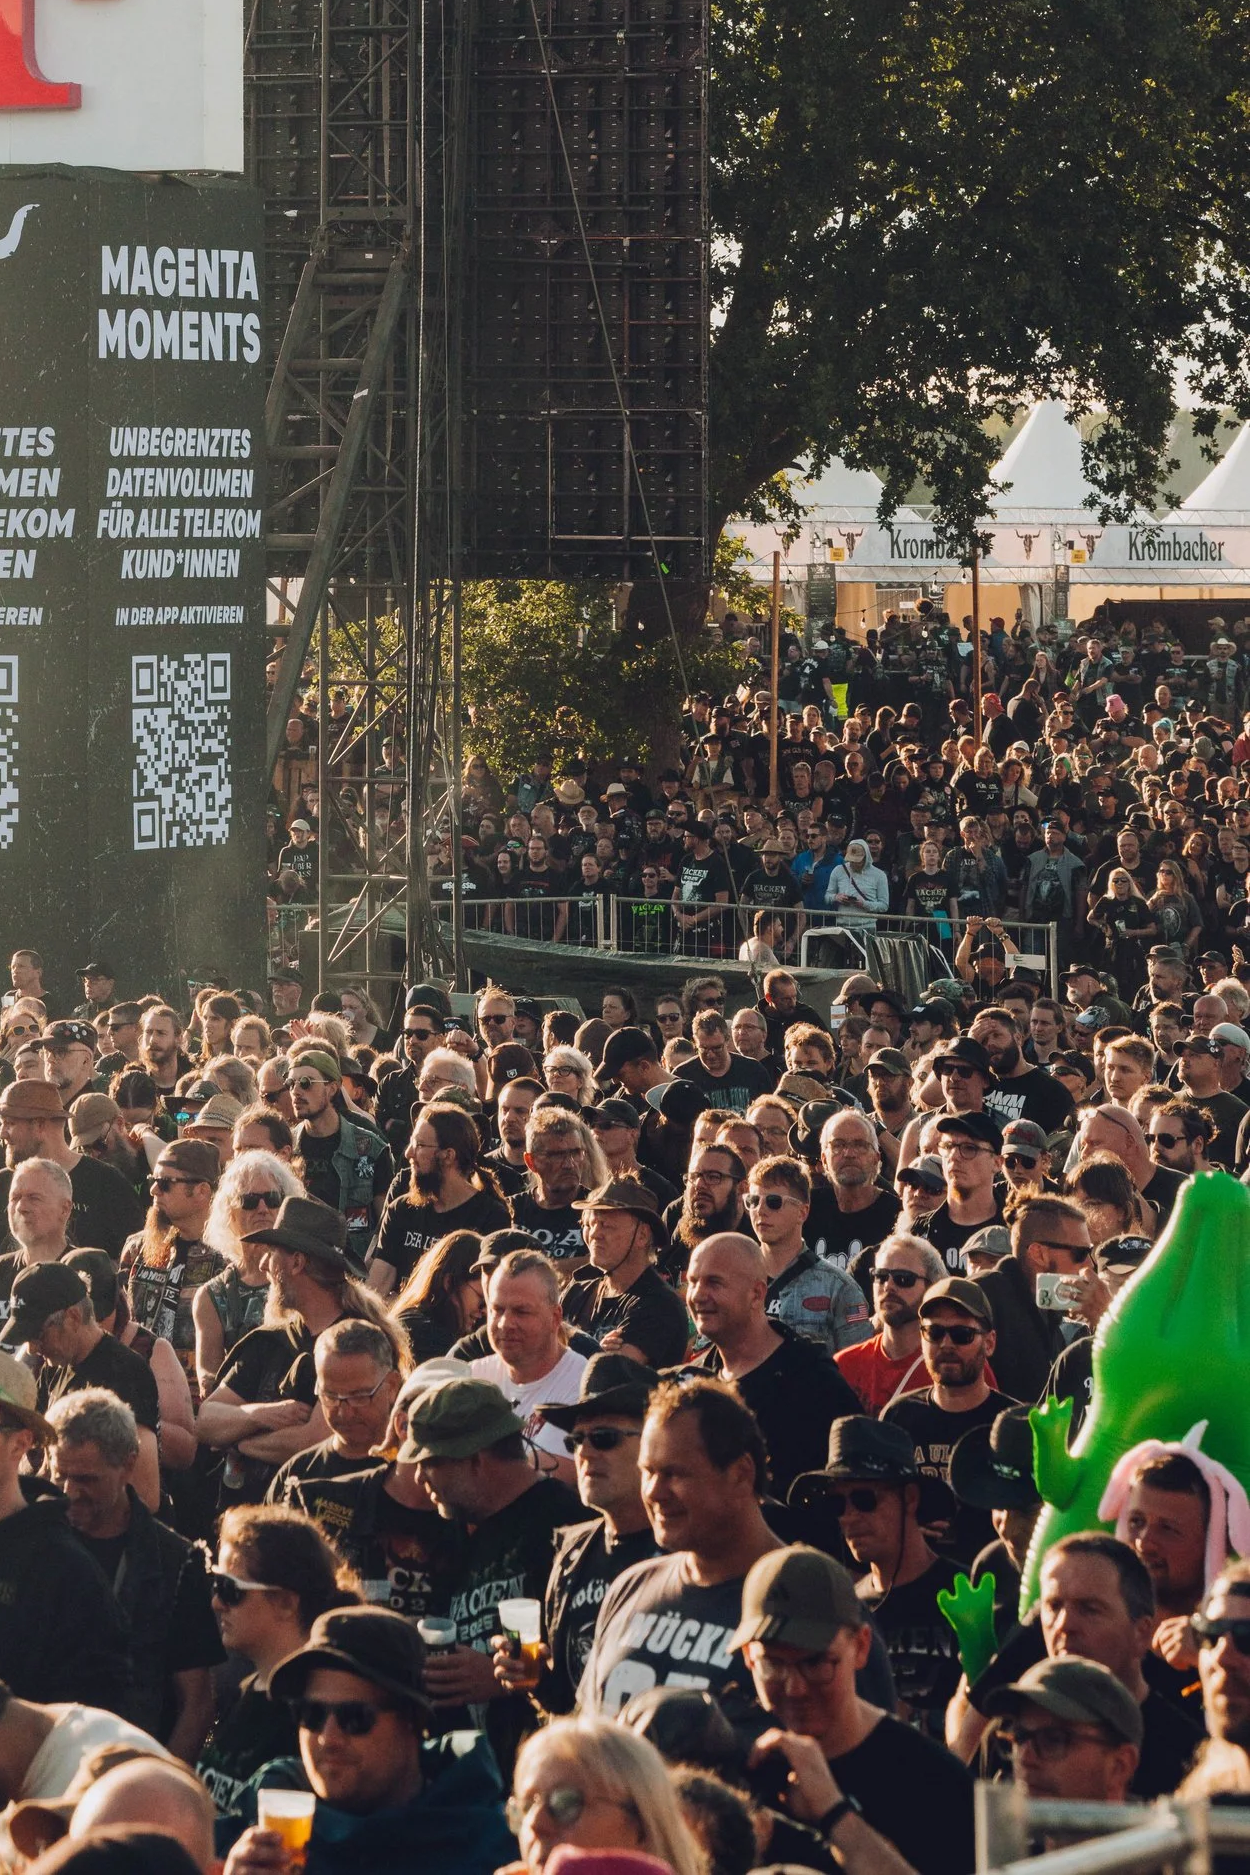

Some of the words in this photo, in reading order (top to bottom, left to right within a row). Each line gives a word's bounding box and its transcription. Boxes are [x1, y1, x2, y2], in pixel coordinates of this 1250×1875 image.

[101, 245, 259, 301] MAGENTA
[98, 310, 262, 364] MOMENTS
[109, 426, 252, 459] UNBEGRENZTES
[106, 467, 254, 498] DATENVOLUMEN
[96, 501, 136, 539] FÜR
[136, 508, 180, 539] ALLE
[181, 508, 262, 539] TELEKOM
[1128, 531, 1226, 562] Krombacher
[116, 606, 129, 626] IN
[130, 606, 154, 626] DER
[155, 606, 178, 625] APP
[179, 606, 244, 625] AKTIVIEREN
[753, 884, 787, 895] WACKEN
[404, 1231, 422, 1249] DER
